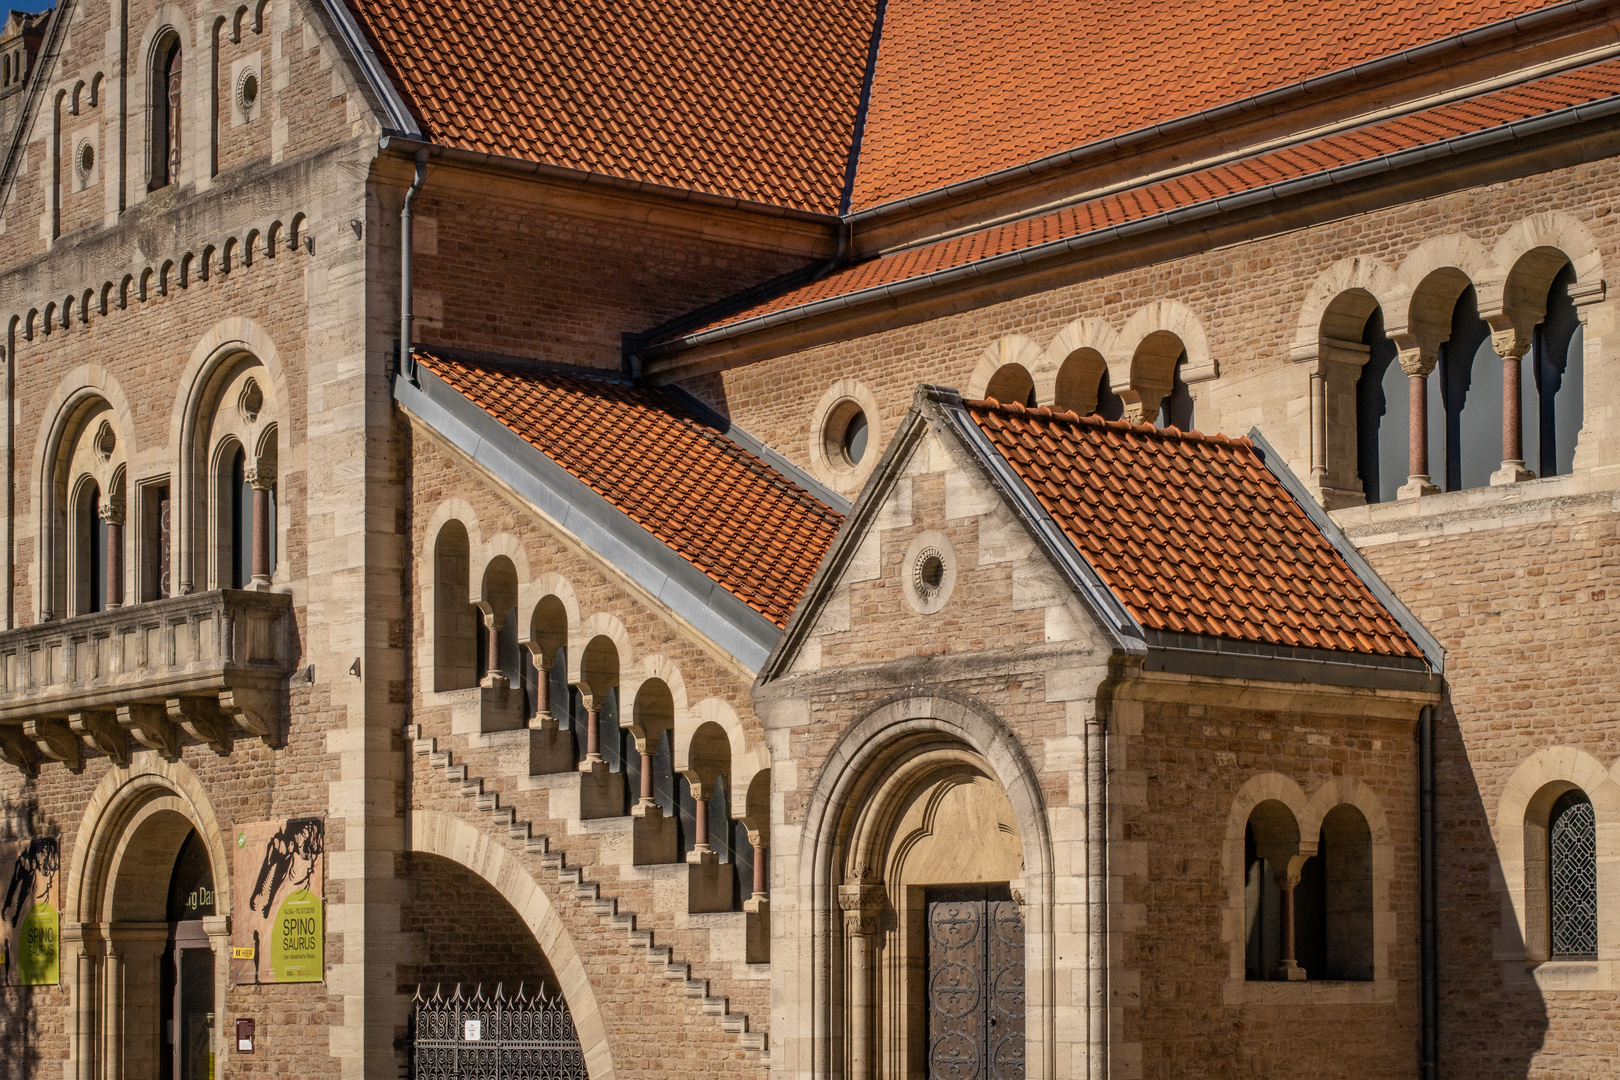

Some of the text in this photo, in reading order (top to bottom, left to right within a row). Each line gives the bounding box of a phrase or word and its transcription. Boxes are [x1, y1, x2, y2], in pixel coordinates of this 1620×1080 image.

[283, 918, 315, 936] SPINO
[28, 927, 54, 943] SPINO
[28, 944, 54, 957] SAURUS
[283, 936, 316, 951] SAURUS
[241, 948, 253, 958] HIER
